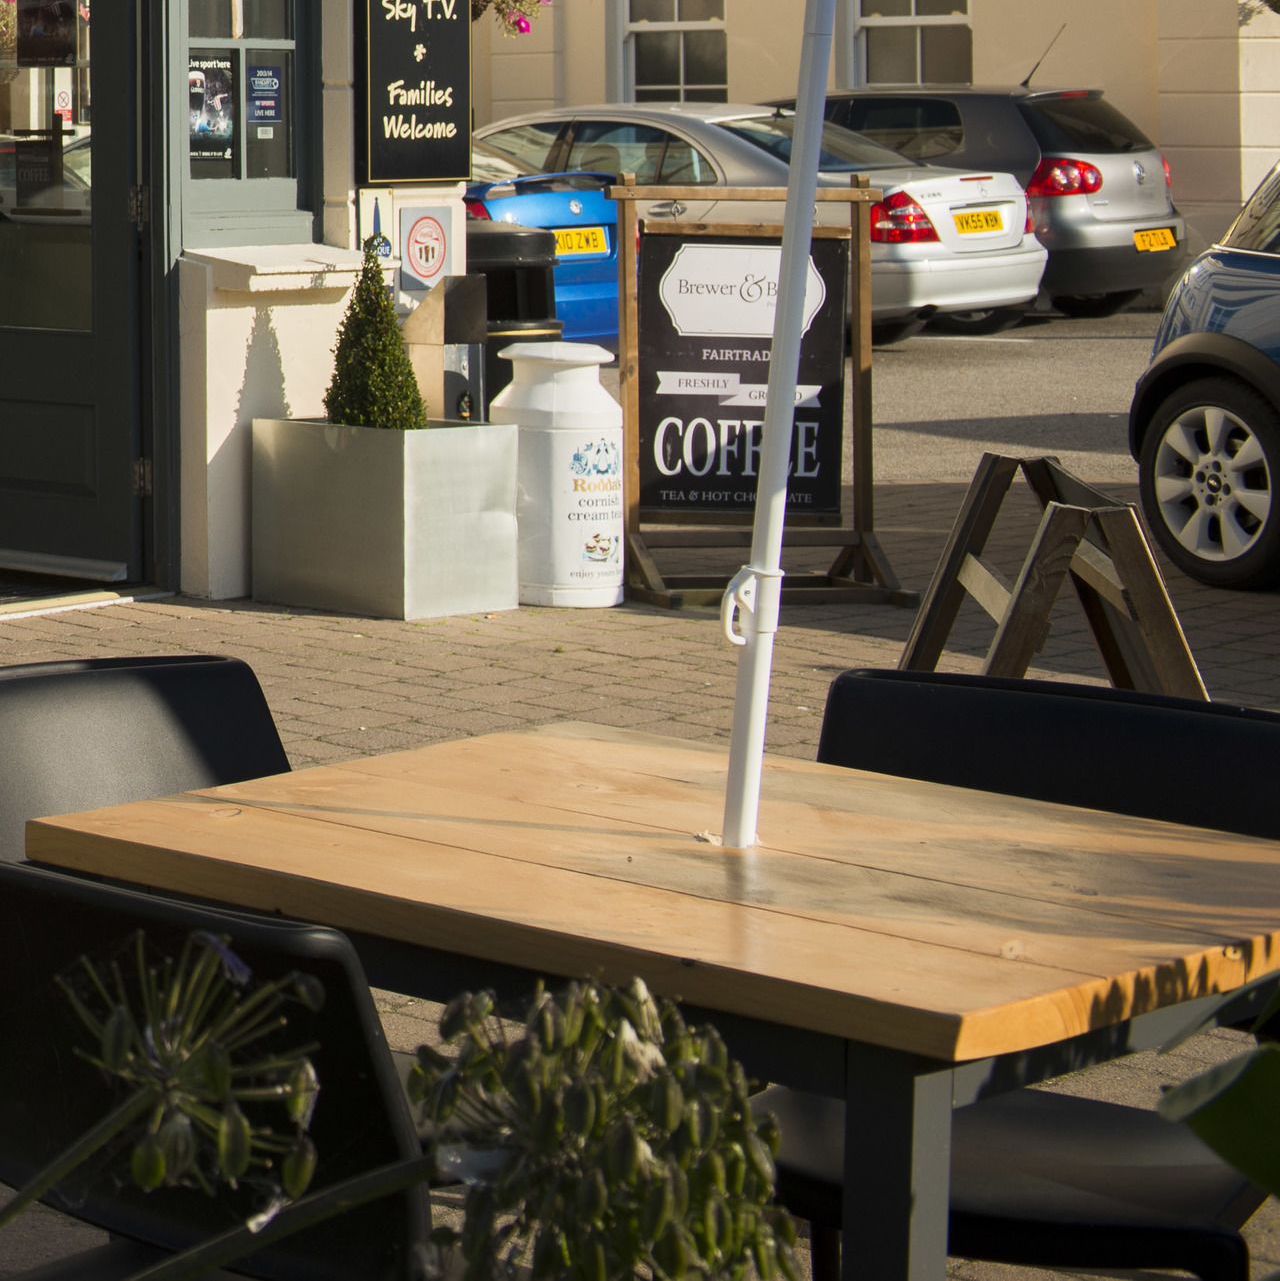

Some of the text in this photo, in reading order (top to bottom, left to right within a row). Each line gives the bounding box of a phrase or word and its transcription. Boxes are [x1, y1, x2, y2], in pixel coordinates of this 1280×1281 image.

[387, 79, 453, 108] Families
[383, 114, 458, 140] Welcome
[678, 278, 737, 296] Brewer
[739, 273, 767, 304] &
[702, 348, 772, 362] FAIRTRAD
[678, 378, 730, 389] FRESHLY
[749, 389, 803, 401] GRD
[653, 416, 821, 477] COFFE
[660, 490, 813, 503] TEA & HOT CHATE
[567, 511, 609, 522] cream
